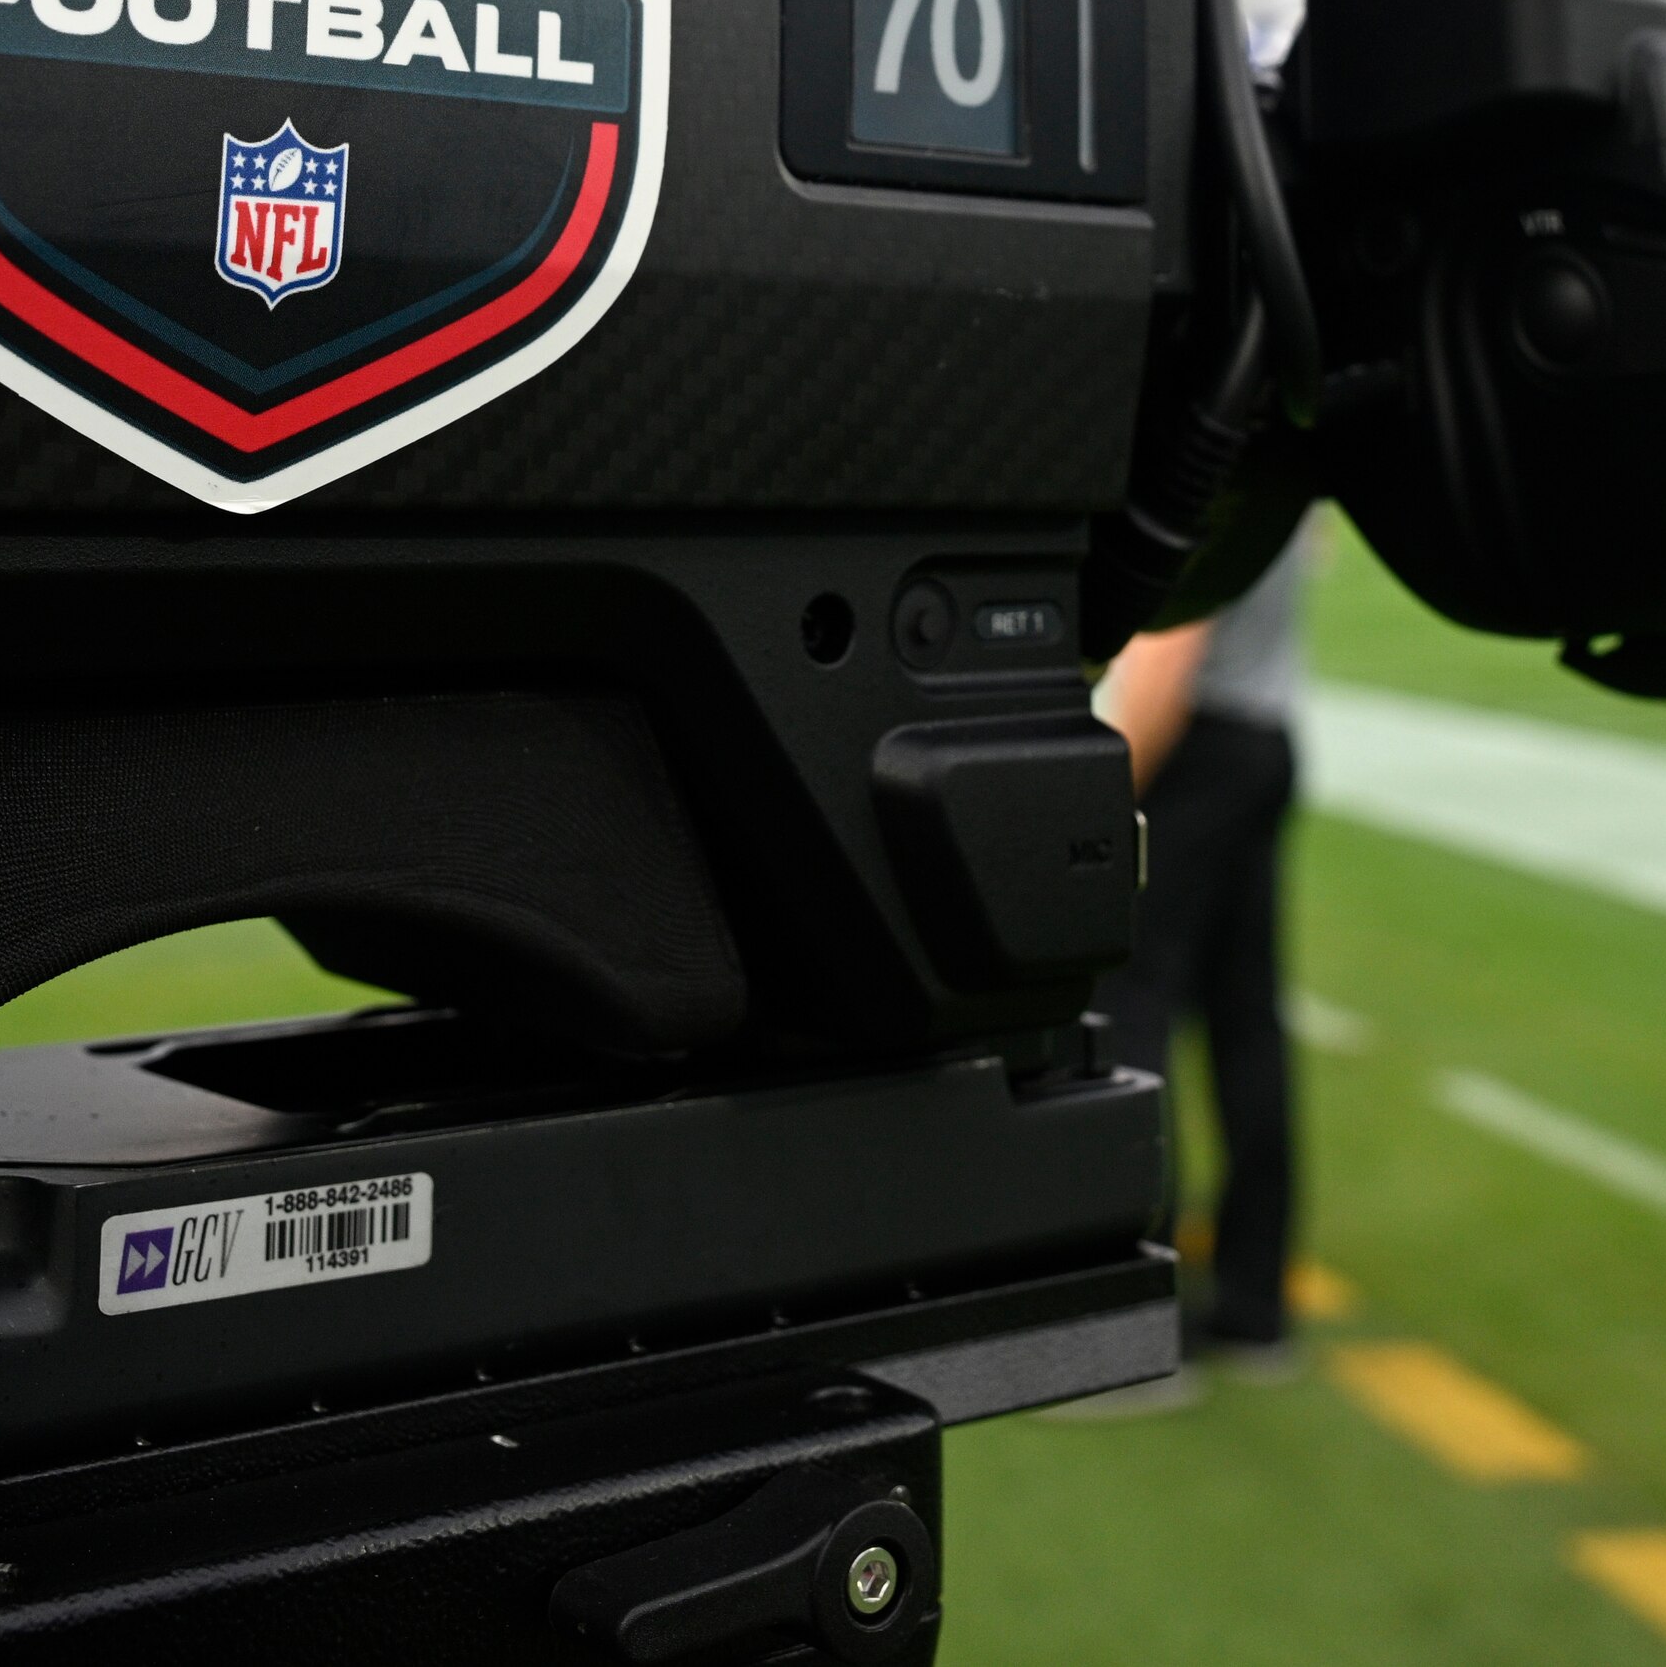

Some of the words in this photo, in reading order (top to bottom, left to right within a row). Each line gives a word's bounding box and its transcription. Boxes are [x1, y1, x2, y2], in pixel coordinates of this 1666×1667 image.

[231, 201, 328, 282] NFL
[264, 1177, 413, 1216] 1-888-842-2486
[172, 1210, 245, 1286] GCV
[306, 1247, 369, 1273] 114391
